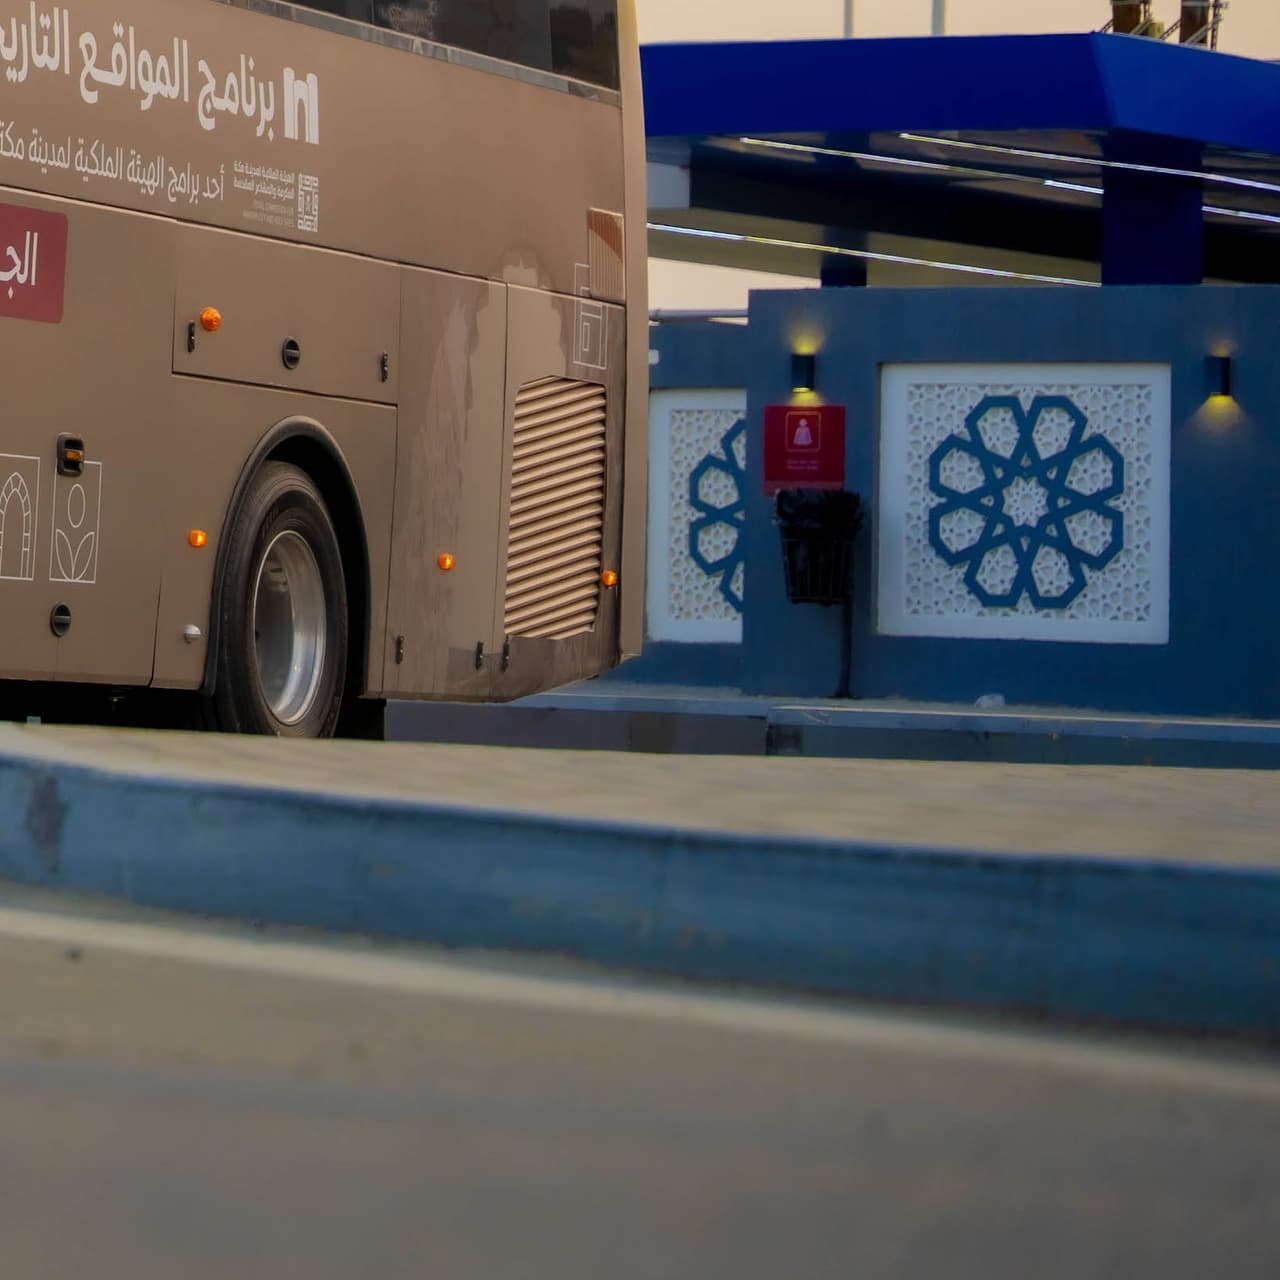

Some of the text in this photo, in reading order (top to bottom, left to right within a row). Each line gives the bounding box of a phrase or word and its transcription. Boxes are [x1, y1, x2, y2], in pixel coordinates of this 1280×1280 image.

[78, 21, 189, 111] المواقع
[197, 53, 275, 141] برنامج
[28, 128, 72, 174] لمدينة
[74, 137, 124, 183] الملكية
[126, 149, 165, 195] الهيئة
[167, 162, 199, 204] برامج
[202, 163, 225, 201] أحد
